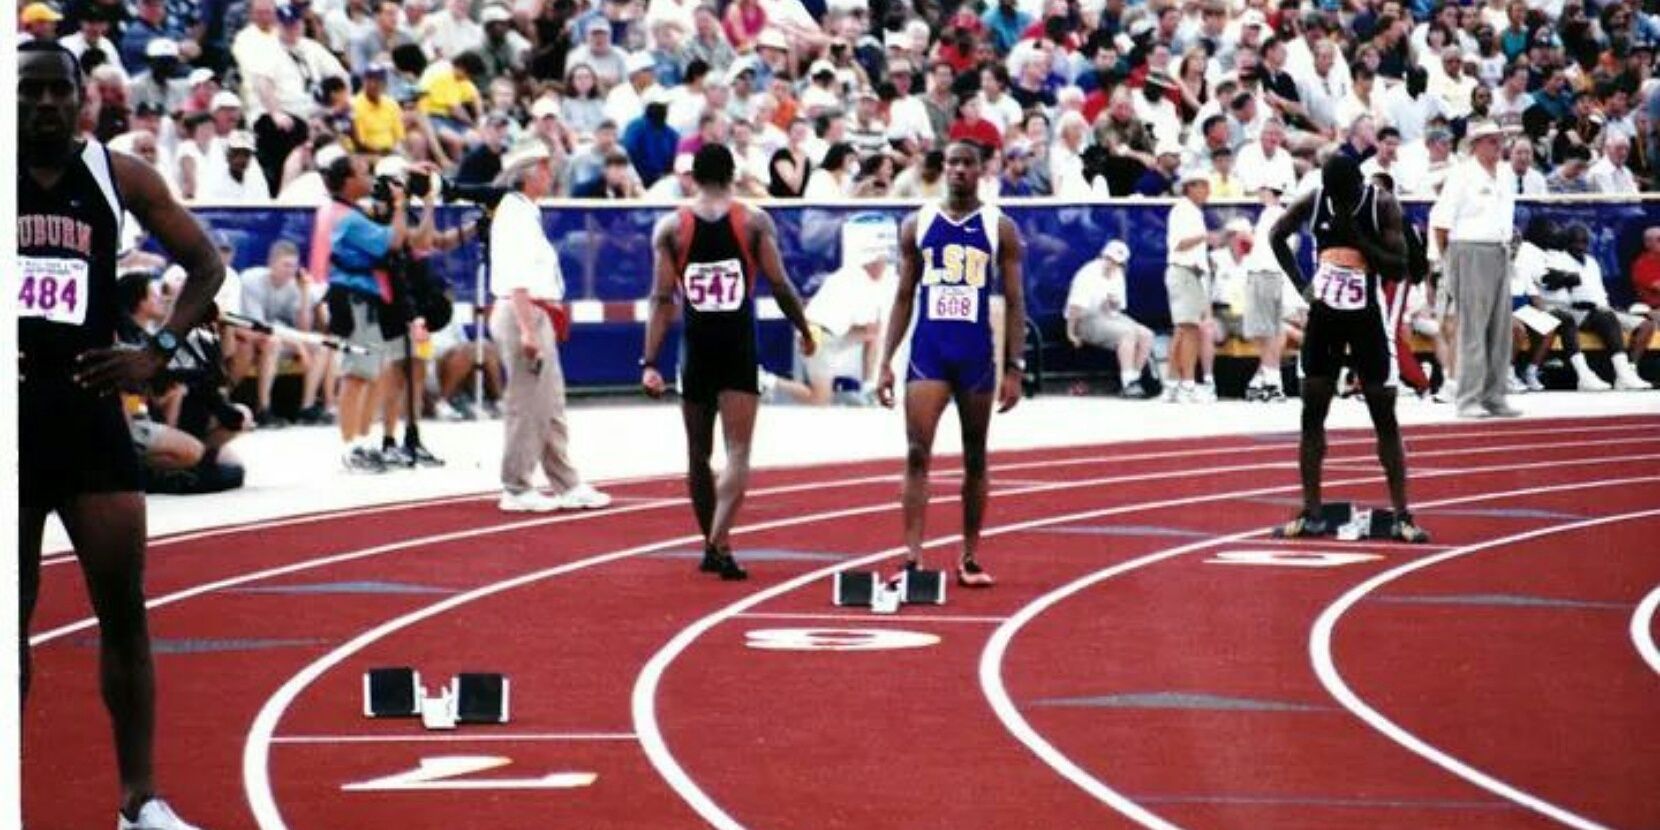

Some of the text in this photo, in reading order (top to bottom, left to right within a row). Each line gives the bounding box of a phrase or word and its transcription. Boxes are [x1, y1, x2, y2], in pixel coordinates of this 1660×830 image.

[922, 244, 990, 288] LSU
[18, 276, 77, 312] 484
[689, 271, 739, 304] 547
[1321, 274, 1363, 303] 775
[936, 296, 972, 316] 608
